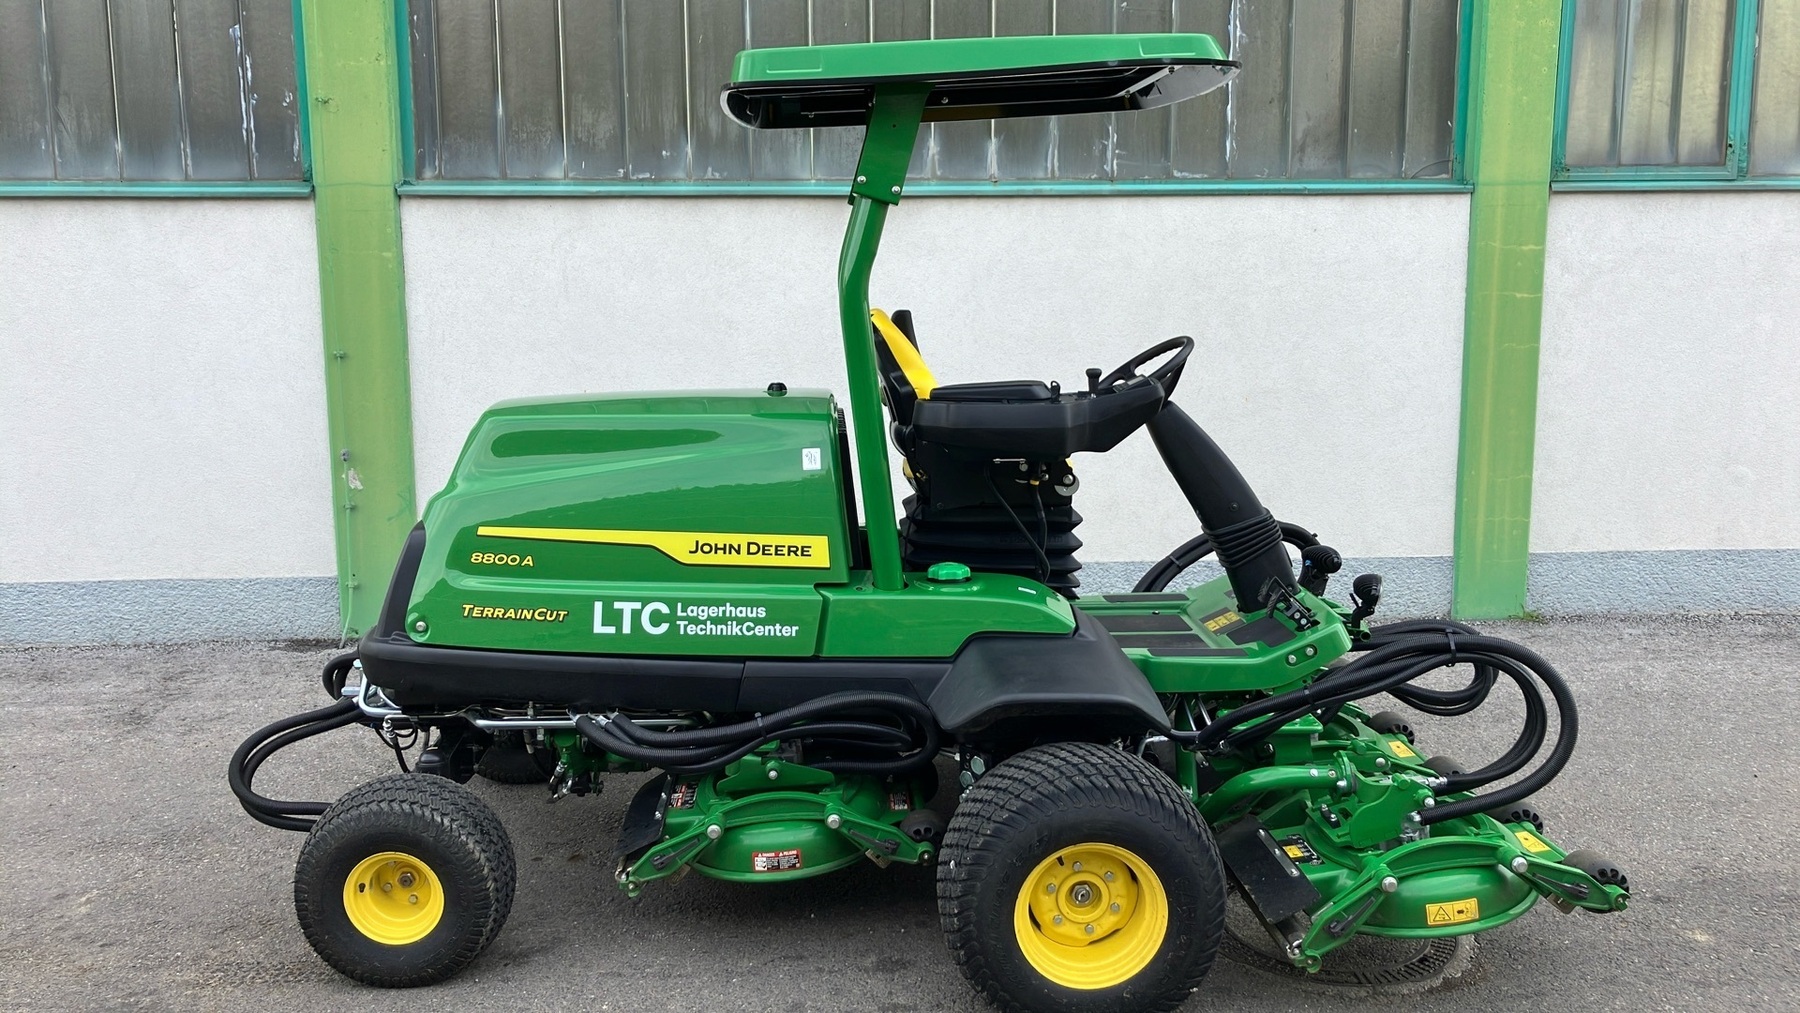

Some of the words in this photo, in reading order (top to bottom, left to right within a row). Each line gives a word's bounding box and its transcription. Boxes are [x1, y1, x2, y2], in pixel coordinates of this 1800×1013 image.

[688, 540, 741, 555] JOHN
[746, 541, 812, 557] DEERE
[470, 552, 520, 566] 8800
[521, 555, 534, 567] A
[592, 600, 670, 635] LTC
[676, 602, 766, 620] Lagerhaus
[676, 620, 799, 637] TechnikCenter
